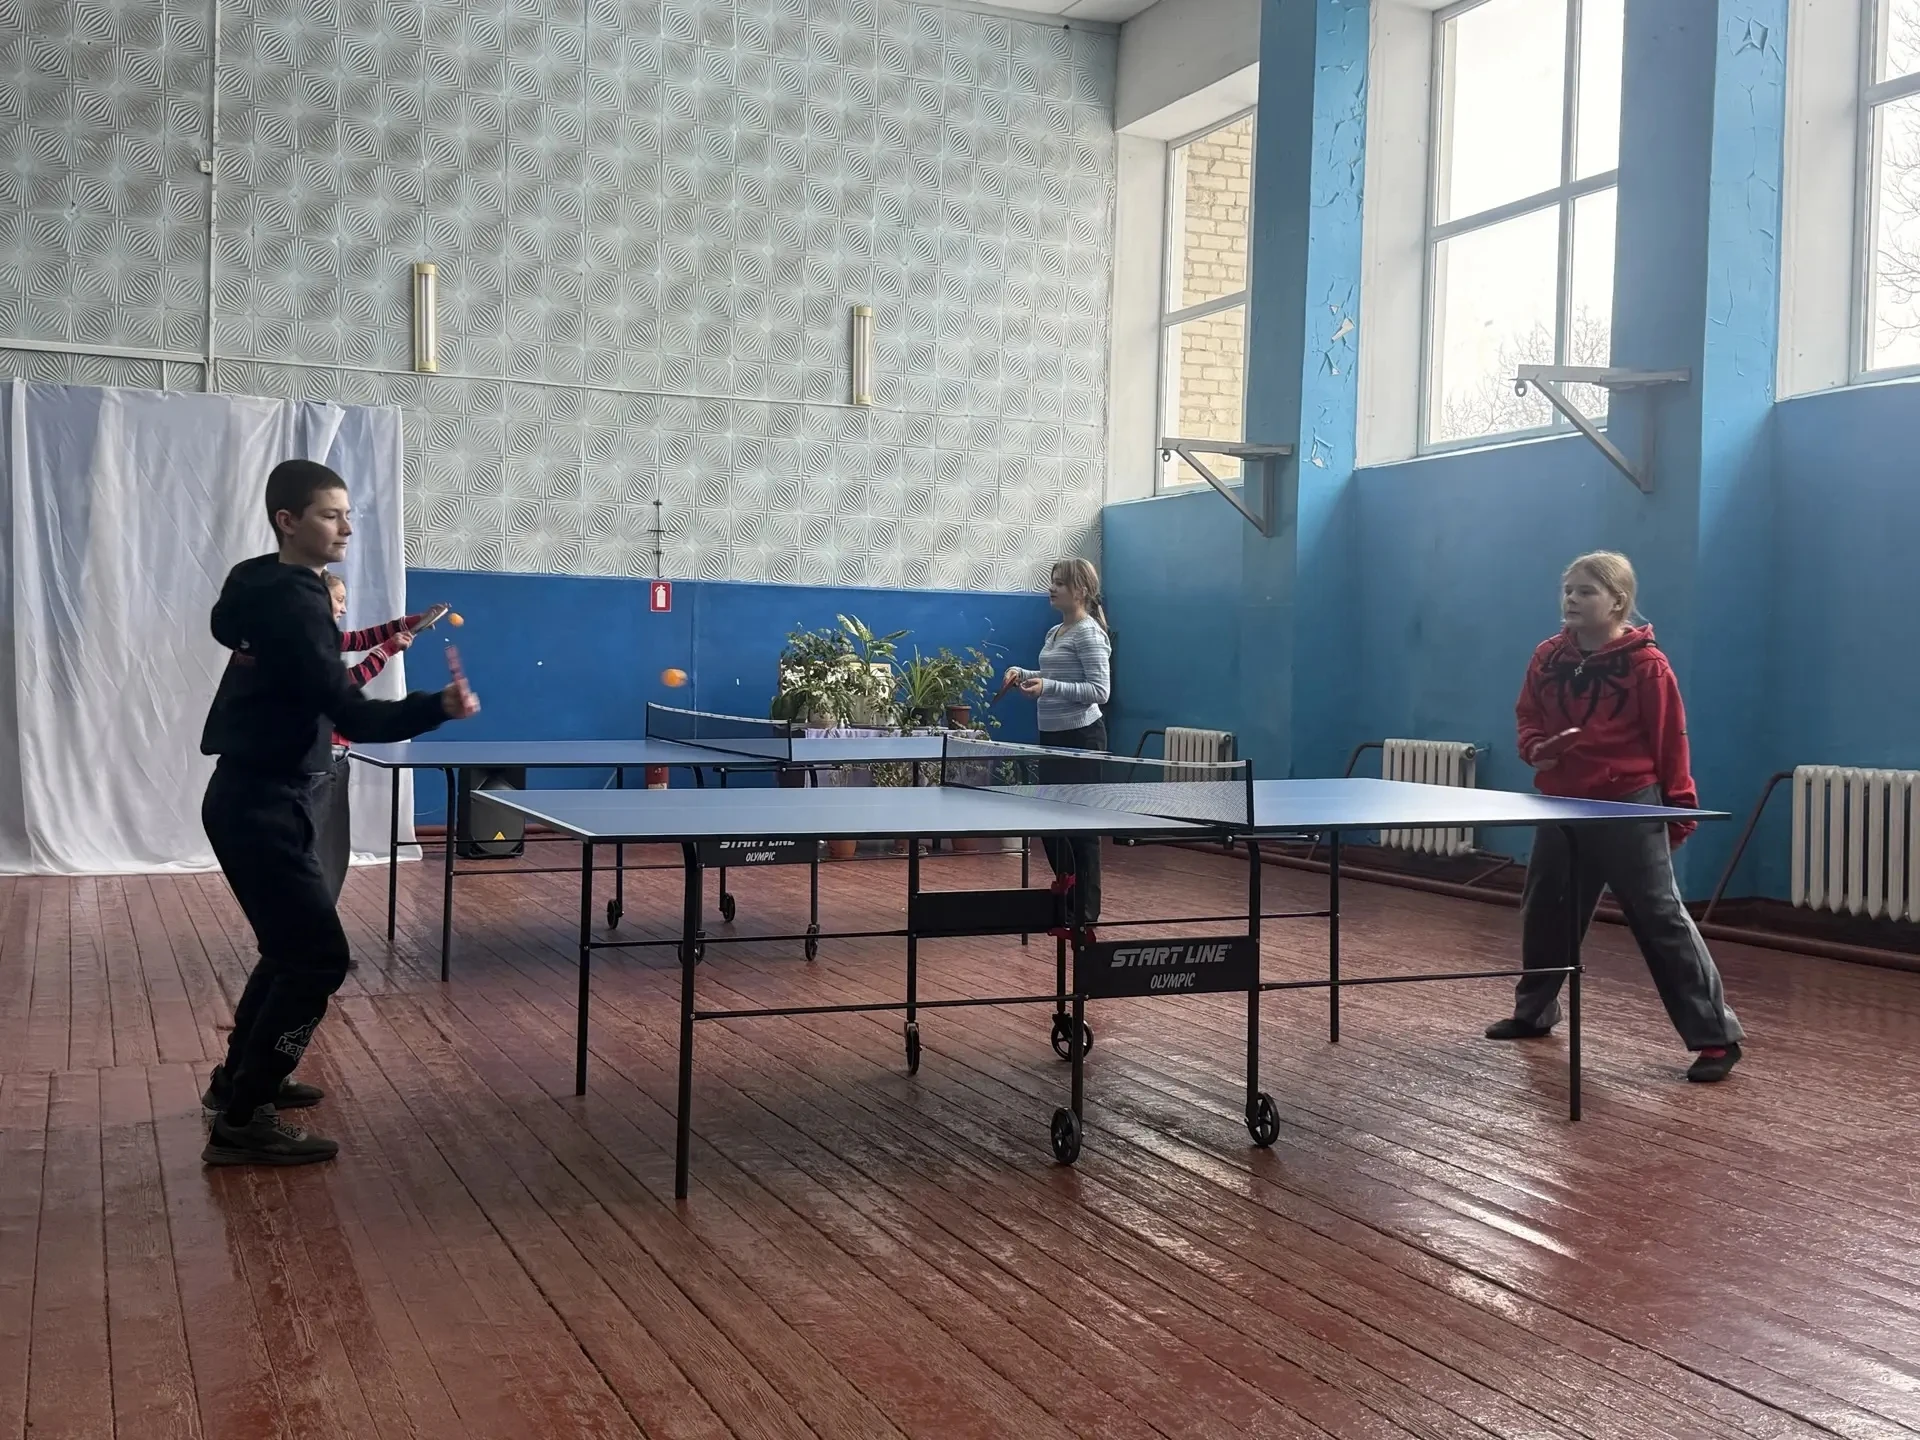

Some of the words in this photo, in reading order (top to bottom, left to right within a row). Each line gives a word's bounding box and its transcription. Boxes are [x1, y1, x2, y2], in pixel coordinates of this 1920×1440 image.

[745, 852, 776, 862] OLYMPIC
[1110, 946, 1184, 968] START
[1184, 944, 1229, 965] LINE
[1150, 973, 1196, 989] OLYMPIC
